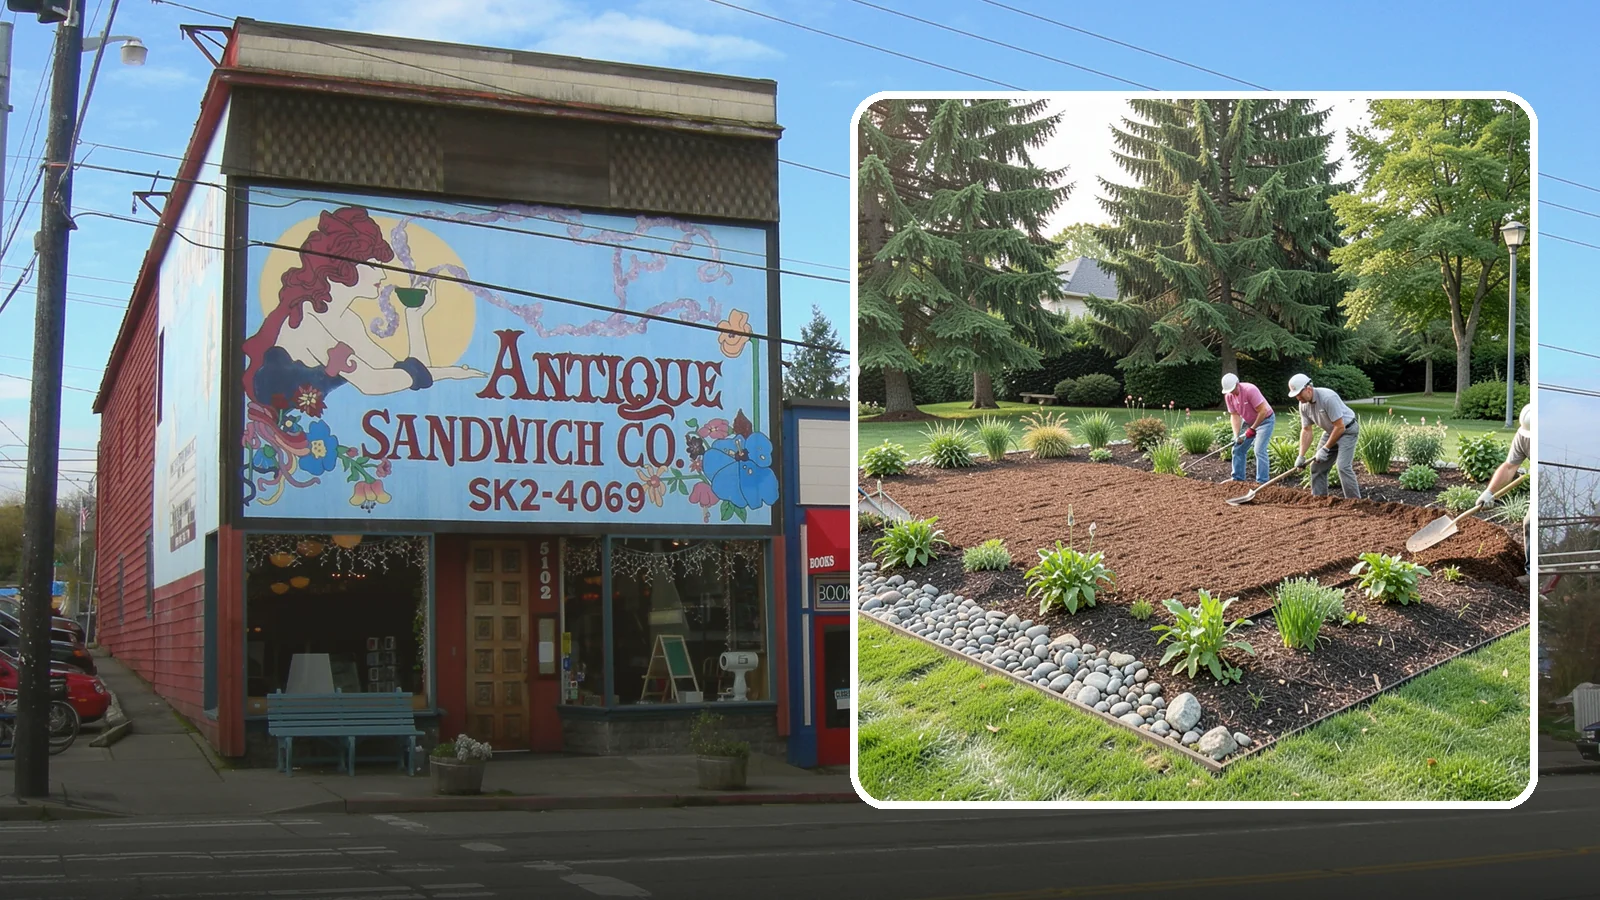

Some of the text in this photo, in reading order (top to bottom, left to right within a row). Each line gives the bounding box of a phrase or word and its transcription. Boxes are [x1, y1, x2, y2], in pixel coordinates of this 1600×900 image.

[476, 329, 723, 421] ANTIQUE
[361, 408, 685, 468] SANDWICH CO.
[468, 477, 646, 513] SK2-4069
[540, 541, 551, 600] 5102
[809, 555, 835, 569] BOOKS
